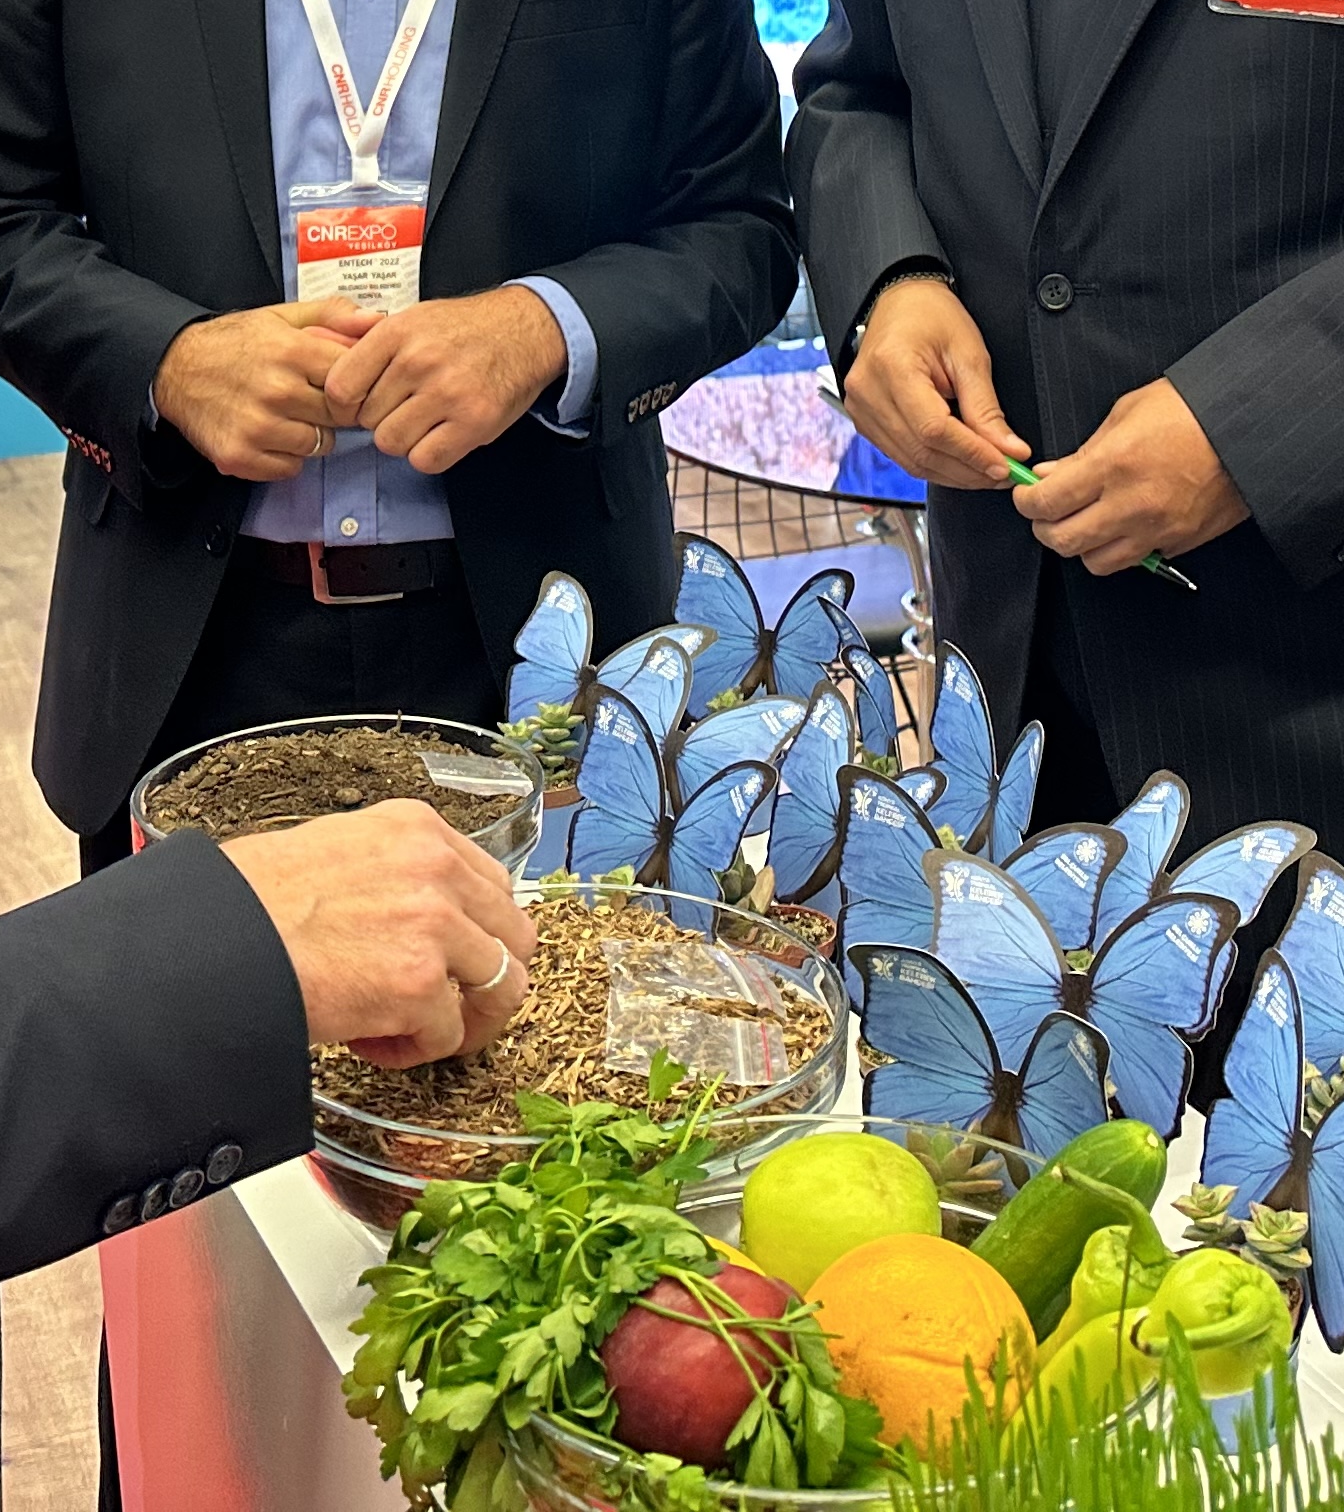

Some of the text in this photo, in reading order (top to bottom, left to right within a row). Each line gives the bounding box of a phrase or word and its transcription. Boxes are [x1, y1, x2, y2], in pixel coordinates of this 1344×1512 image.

[306, 223, 398, 243] CNREXPO
[338, 257, 400, 268] ENTECH 2022
